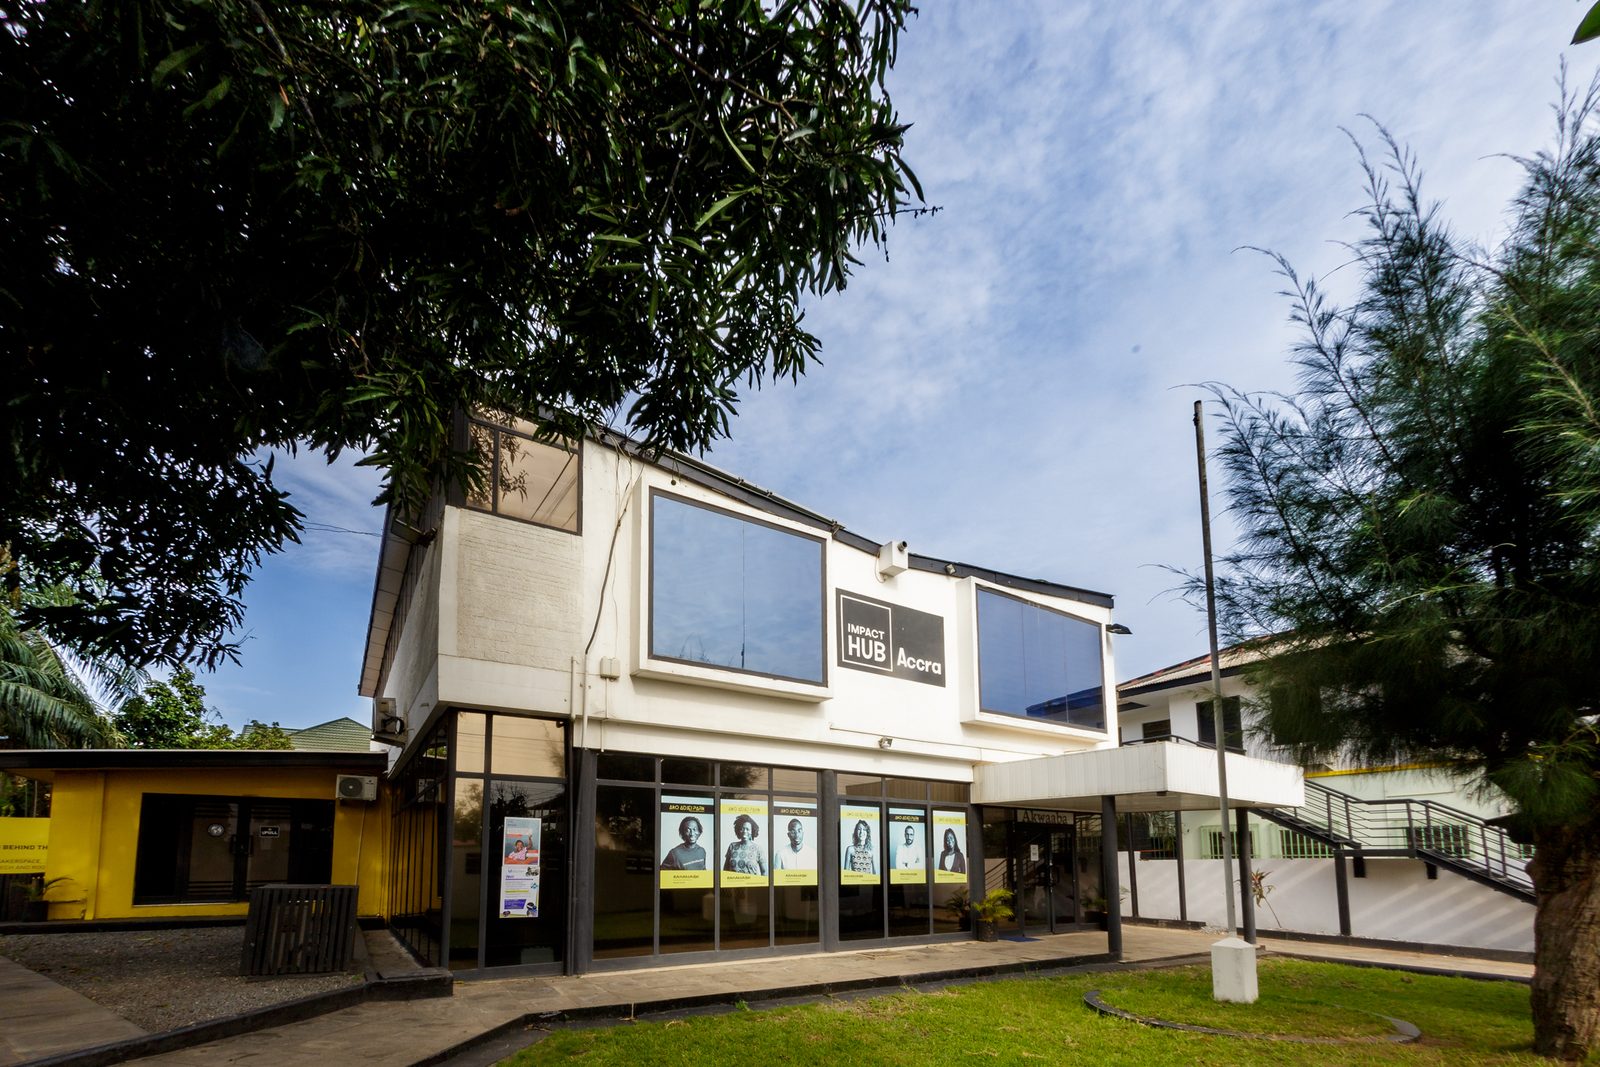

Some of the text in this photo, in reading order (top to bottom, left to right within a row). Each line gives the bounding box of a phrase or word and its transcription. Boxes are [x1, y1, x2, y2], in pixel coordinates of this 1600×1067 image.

[847, 623, 885, 640] IMPACT
[848, 635, 887, 662] HUB
[897, 647, 942, 675] Accra
[1022, 810, 1067, 824] Akwaaba
